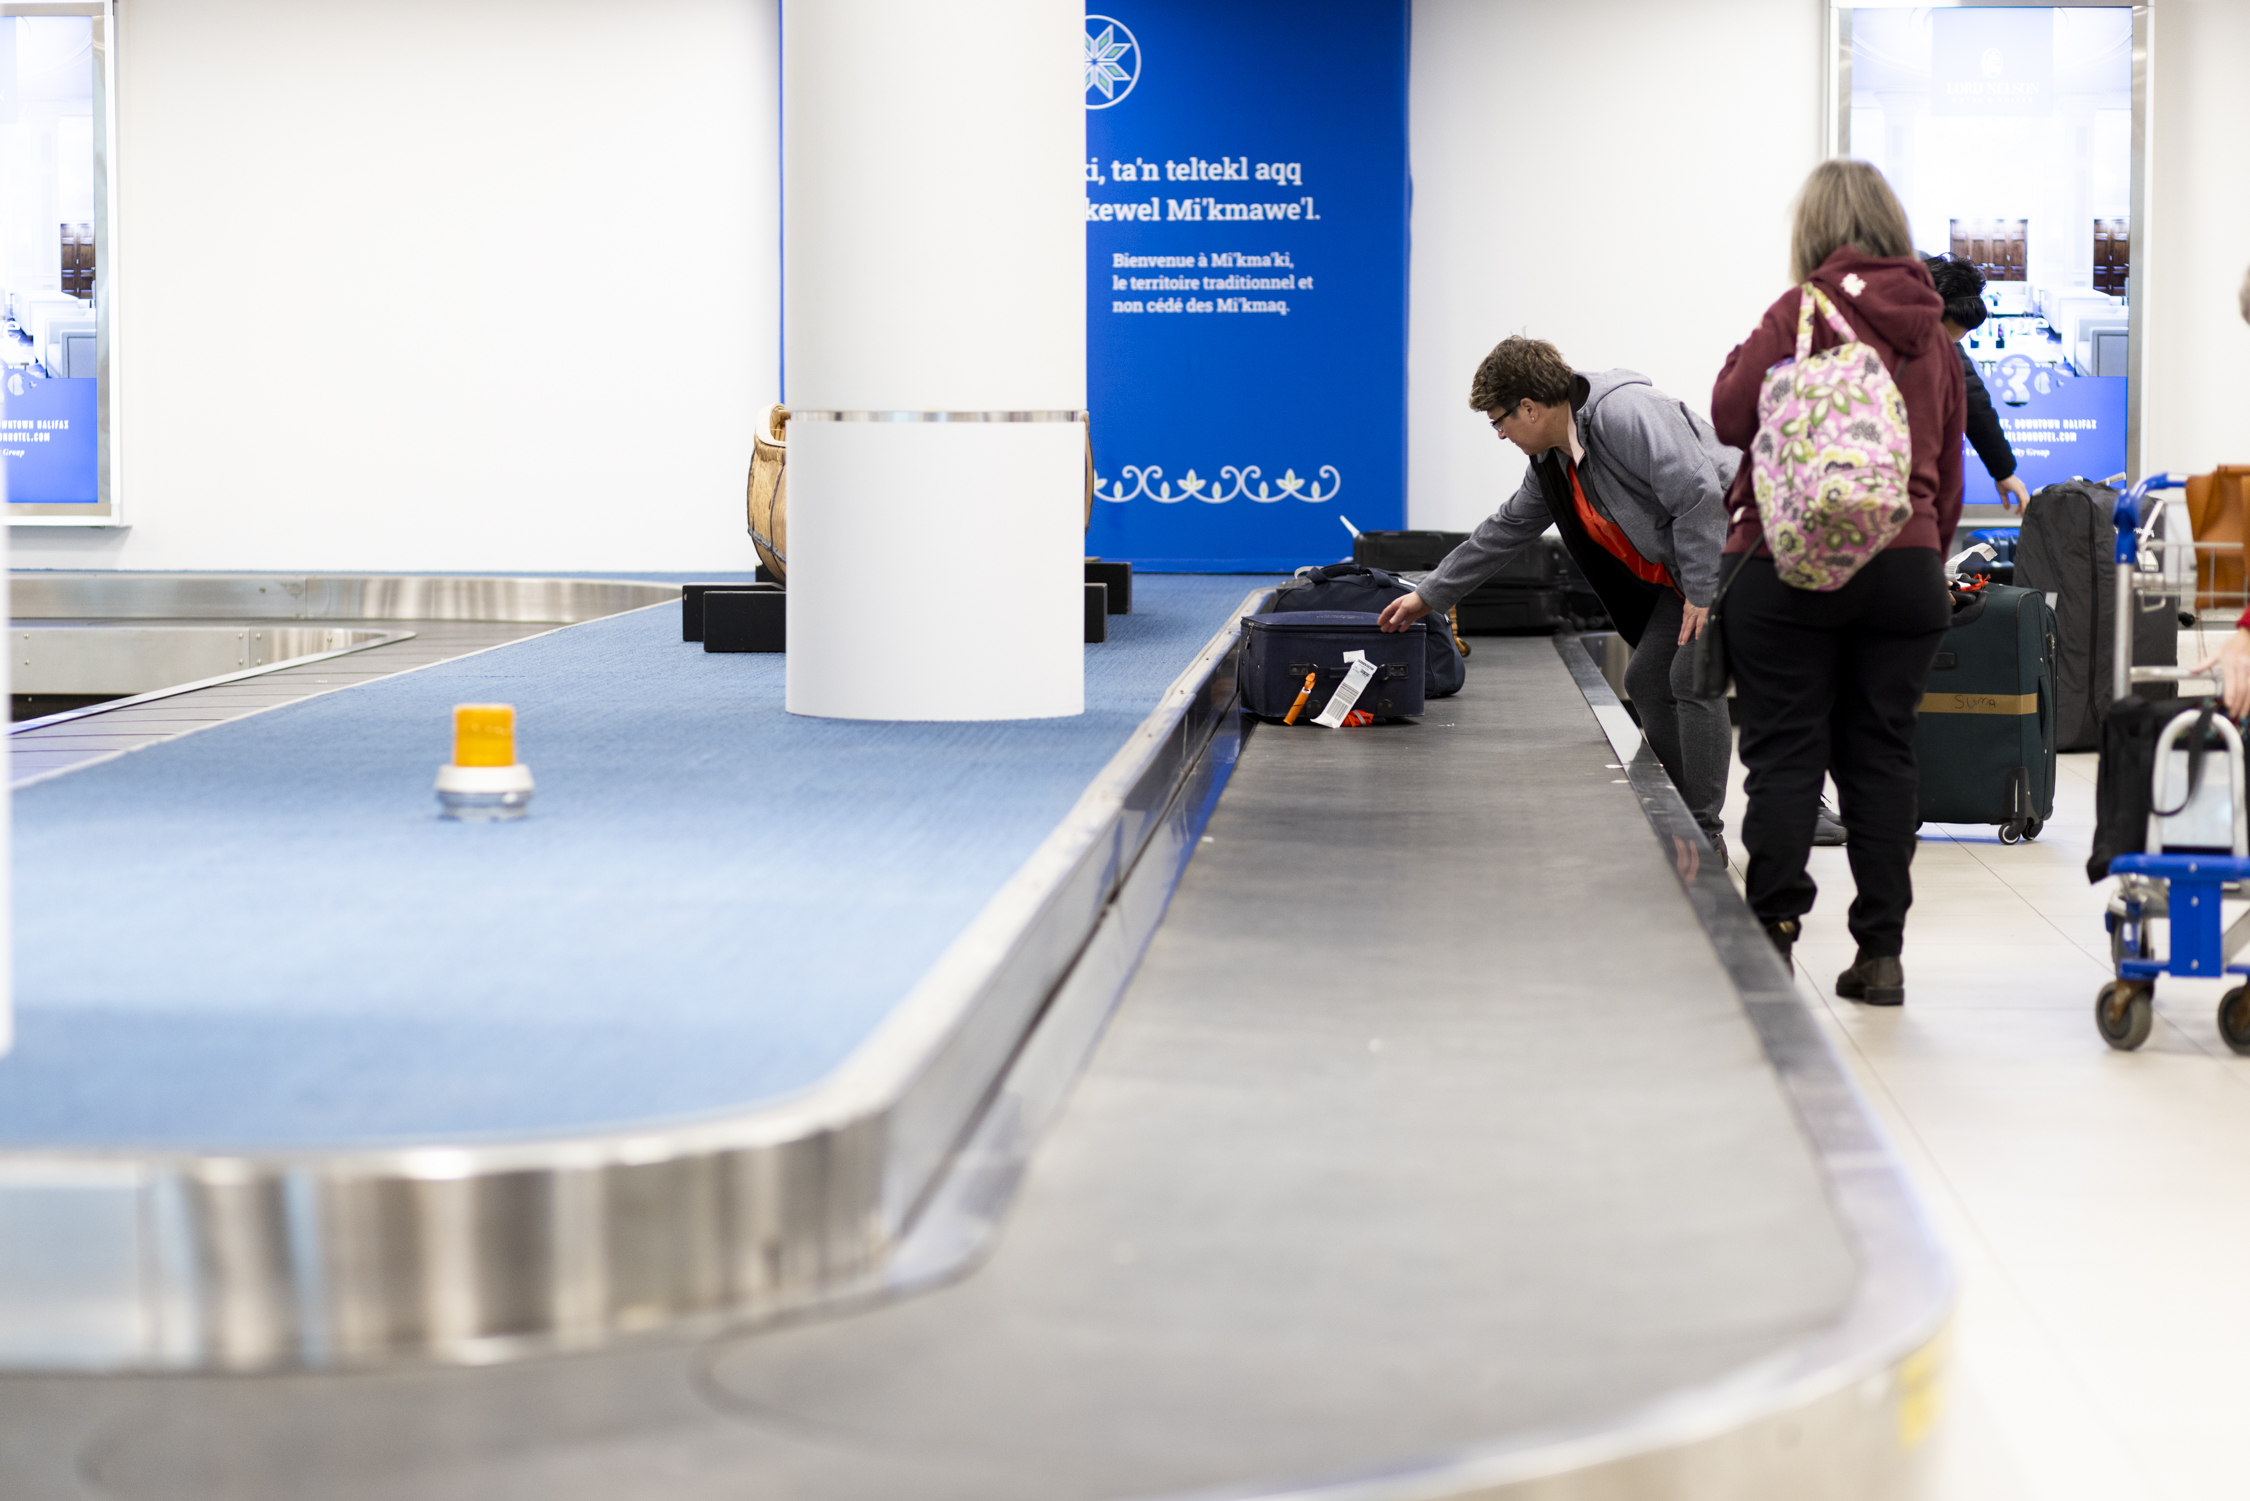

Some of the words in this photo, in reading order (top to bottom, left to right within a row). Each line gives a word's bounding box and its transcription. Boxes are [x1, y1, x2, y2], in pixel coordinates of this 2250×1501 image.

[1111, 157, 1160, 181] ta'n
[1165, 156, 1249, 181] teltekl
[1255, 162, 1303, 186] aqq
[1085, 197, 1161, 221] kewel
[1166, 197, 1321, 221] Mi'kmawe'l.
[1112, 252, 1195, 268] Bienvenue
[1197, 252, 1208, 268] à
[1211, 252, 1294, 269] Mi'kma'ki,
[1112, 274, 1128, 290] le
[1130, 274, 1200, 290] territoire
[1203, 274, 1296, 290] traditionnel
[1298, 276, 1314, 290] et
[1112, 300, 1144, 313] non
[1146, 297, 1183, 313] cédé
[1186, 297, 1214, 313] des
[1216, 297, 1290, 316] Mi'kmaq.
[0, 420, 34, 430] WNTOWN
[37, 420, 69, 430] HALIFAX
[2015, 418, 2060, 430] DOWNTOWN
[2063, 419, 2097, 430] HALIFAX
[2026, 447, 2050, 458] Group
